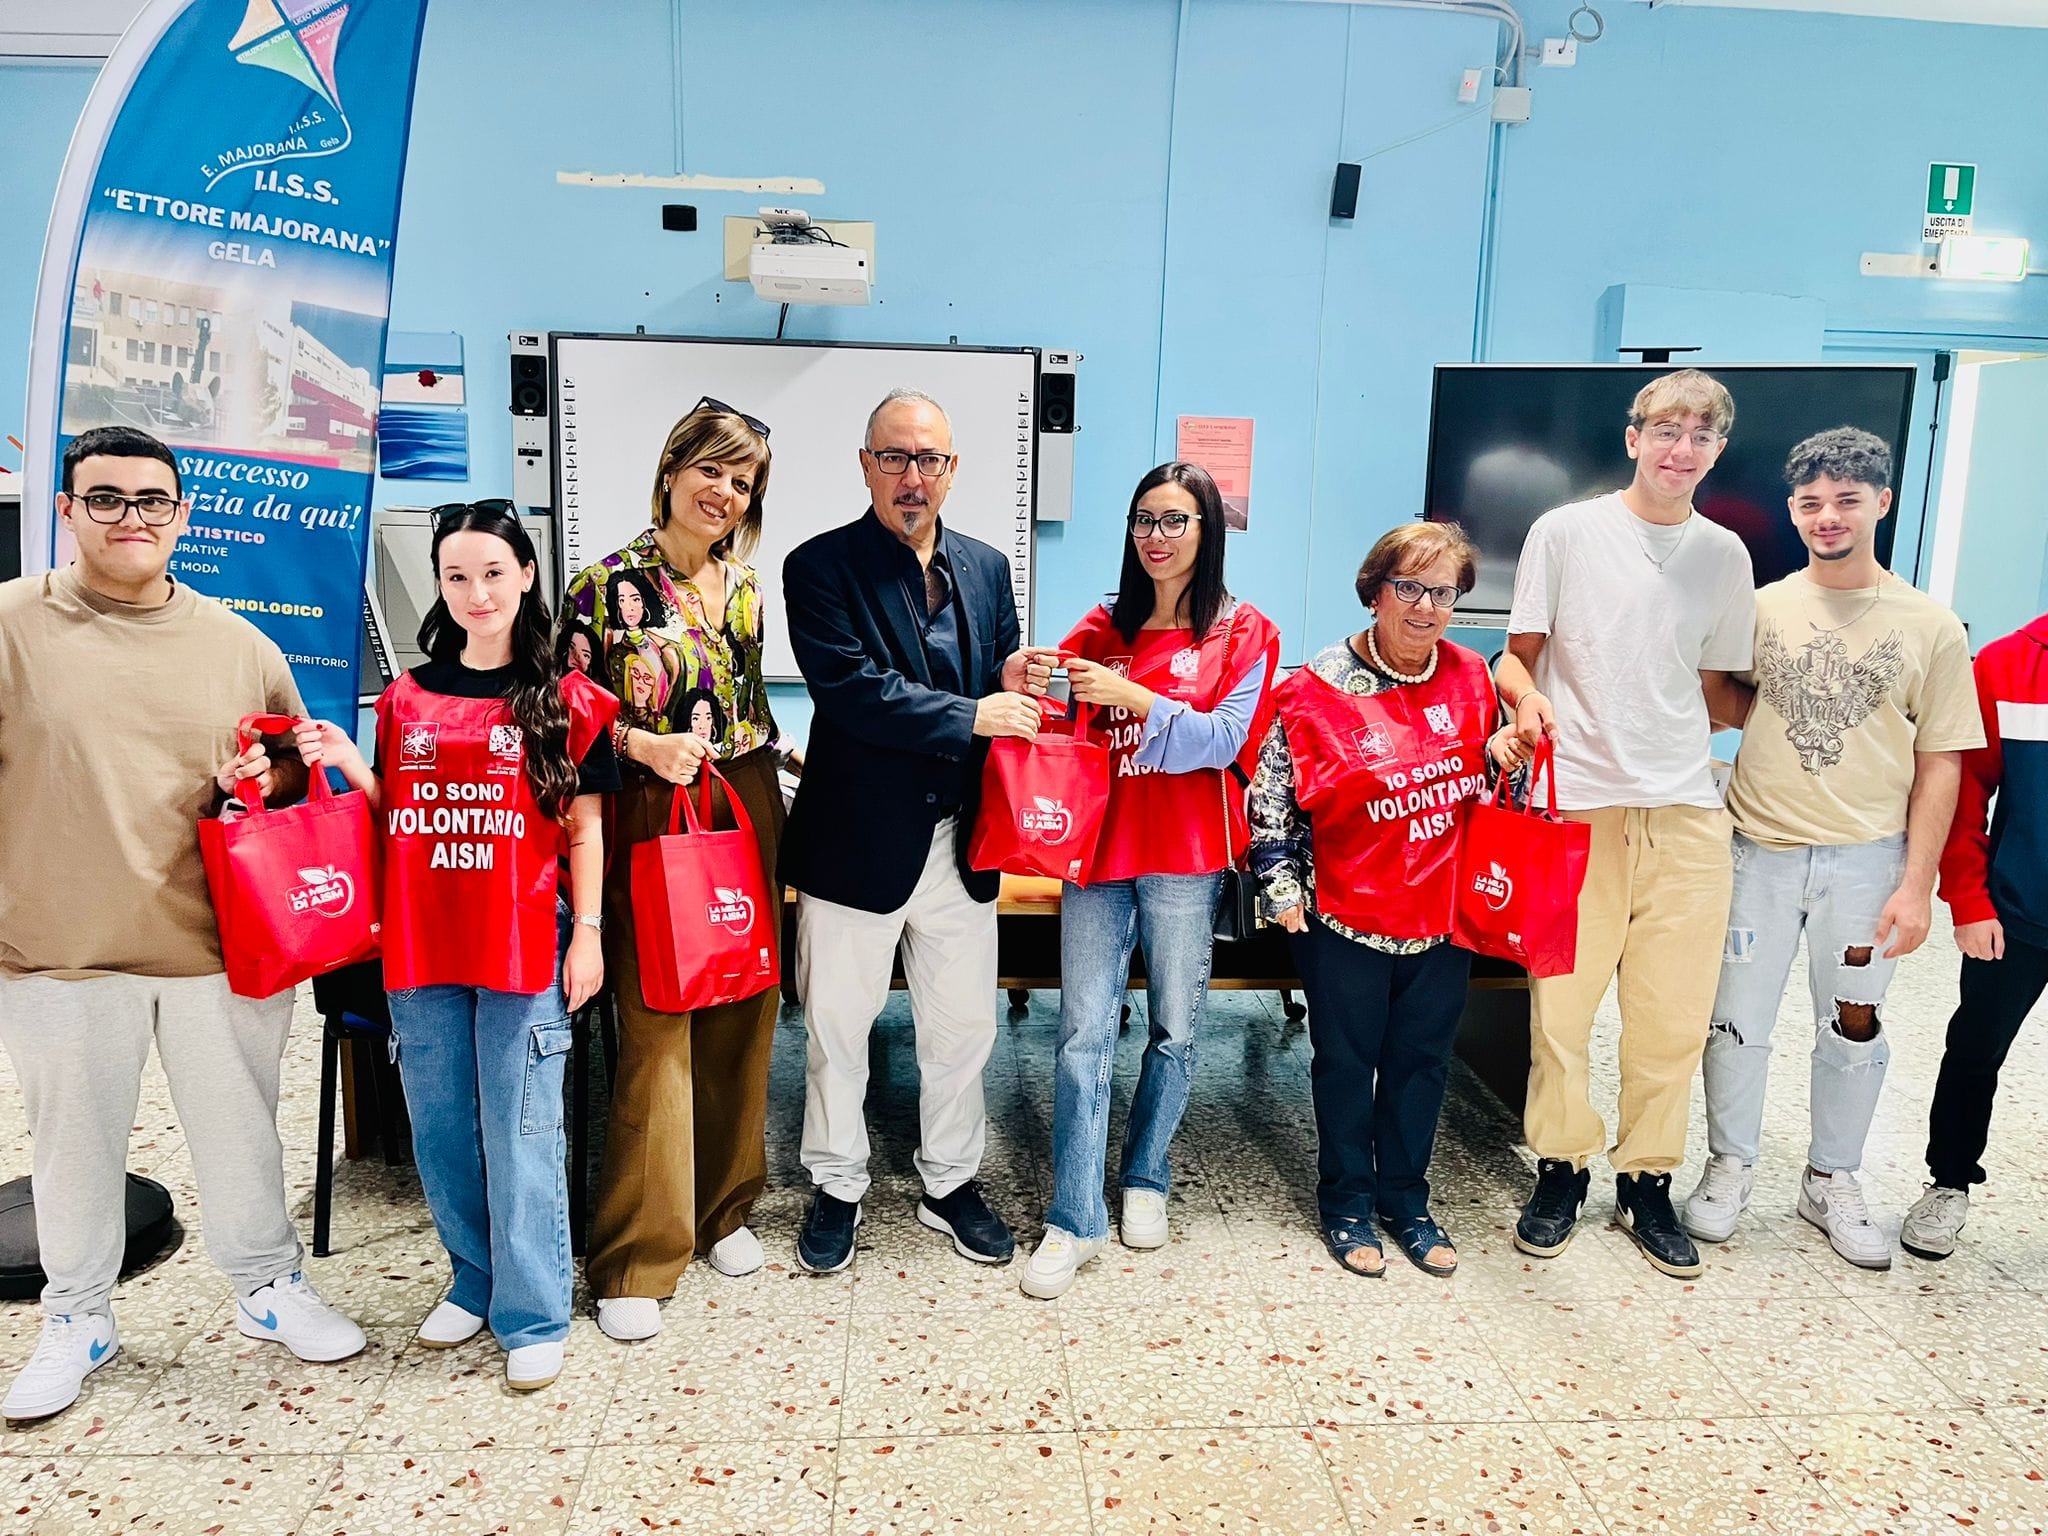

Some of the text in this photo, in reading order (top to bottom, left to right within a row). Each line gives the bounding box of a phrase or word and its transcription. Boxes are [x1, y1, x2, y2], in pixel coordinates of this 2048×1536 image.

[289, 111, 326, 134] I.I.S.S.
[201, 136, 340, 178] E. MAJORANA Gela
[255, 170, 339, 205] I.I.S.S.
[1930, 217, 1966, 227] USCITA DI
[208, 241, 277, 269] GELA
[178, 456, 310, 490] successo
[182, 484, 362, 531] izia da qui!
[182, 525, 265, 545] RTISTICO
[169, 561, 220, 575] E MODA
[1384, 772, 1408, 792] IO
[1410, 756, 1464, 784] SONO
[412, 782, 505, 801] IO SONO
[388, 807, 525, 840] VOLONTARIO
[1022, 812, 1035, 820] LA
[1022, 820, 1034, 829] DI
[430, 842, 494, 870] AISM
[1473, 881, 1485, 891] DI
[1476, 875, 1488, 883] LA
[290, 881, 342, 902] LA MELA
[292, 900, 309, 911] DI
[708, 905, 720, 914] LA
[710, 913, 721, 923] DI
